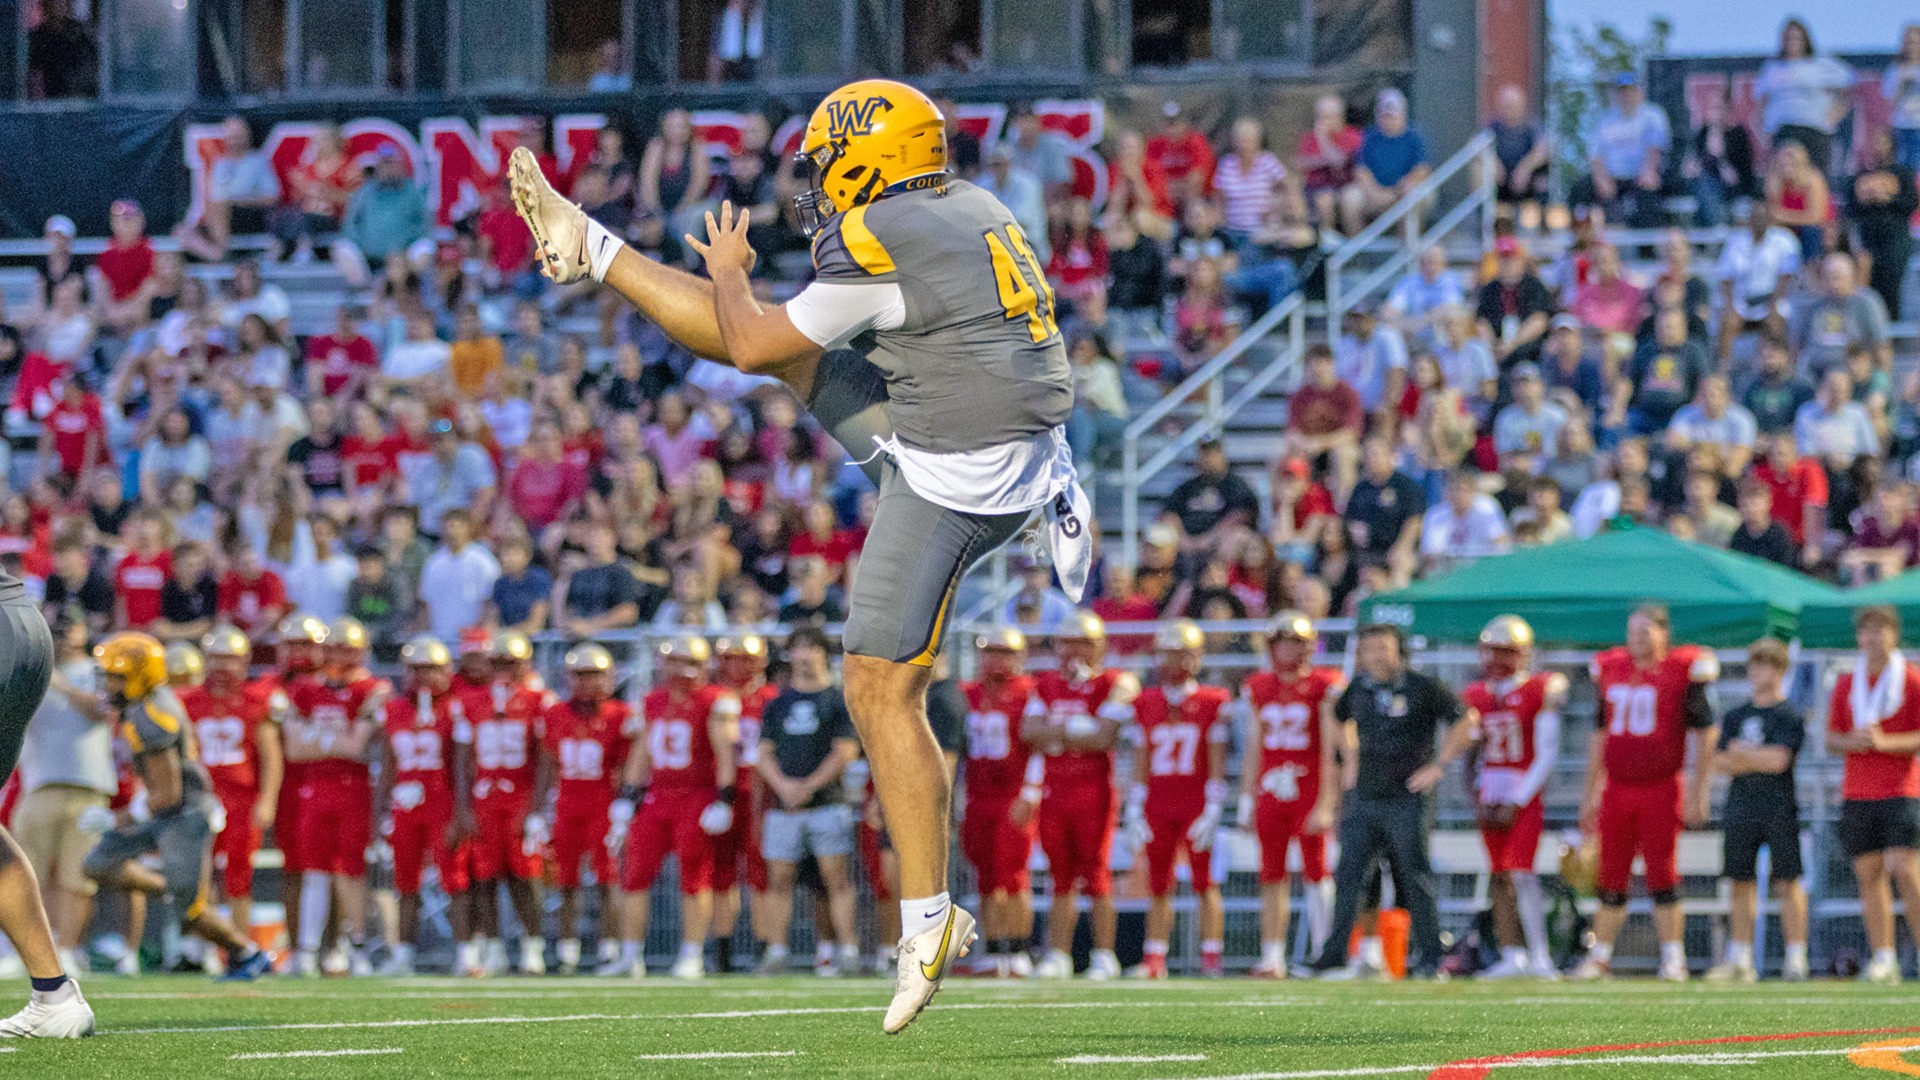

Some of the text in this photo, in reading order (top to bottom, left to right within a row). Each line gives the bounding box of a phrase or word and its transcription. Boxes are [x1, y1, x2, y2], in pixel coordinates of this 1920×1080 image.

[827, 97, 887, 139] W
[1606, 684, 1657, 735] 70
[1150, 722, 1199, 776] 27
